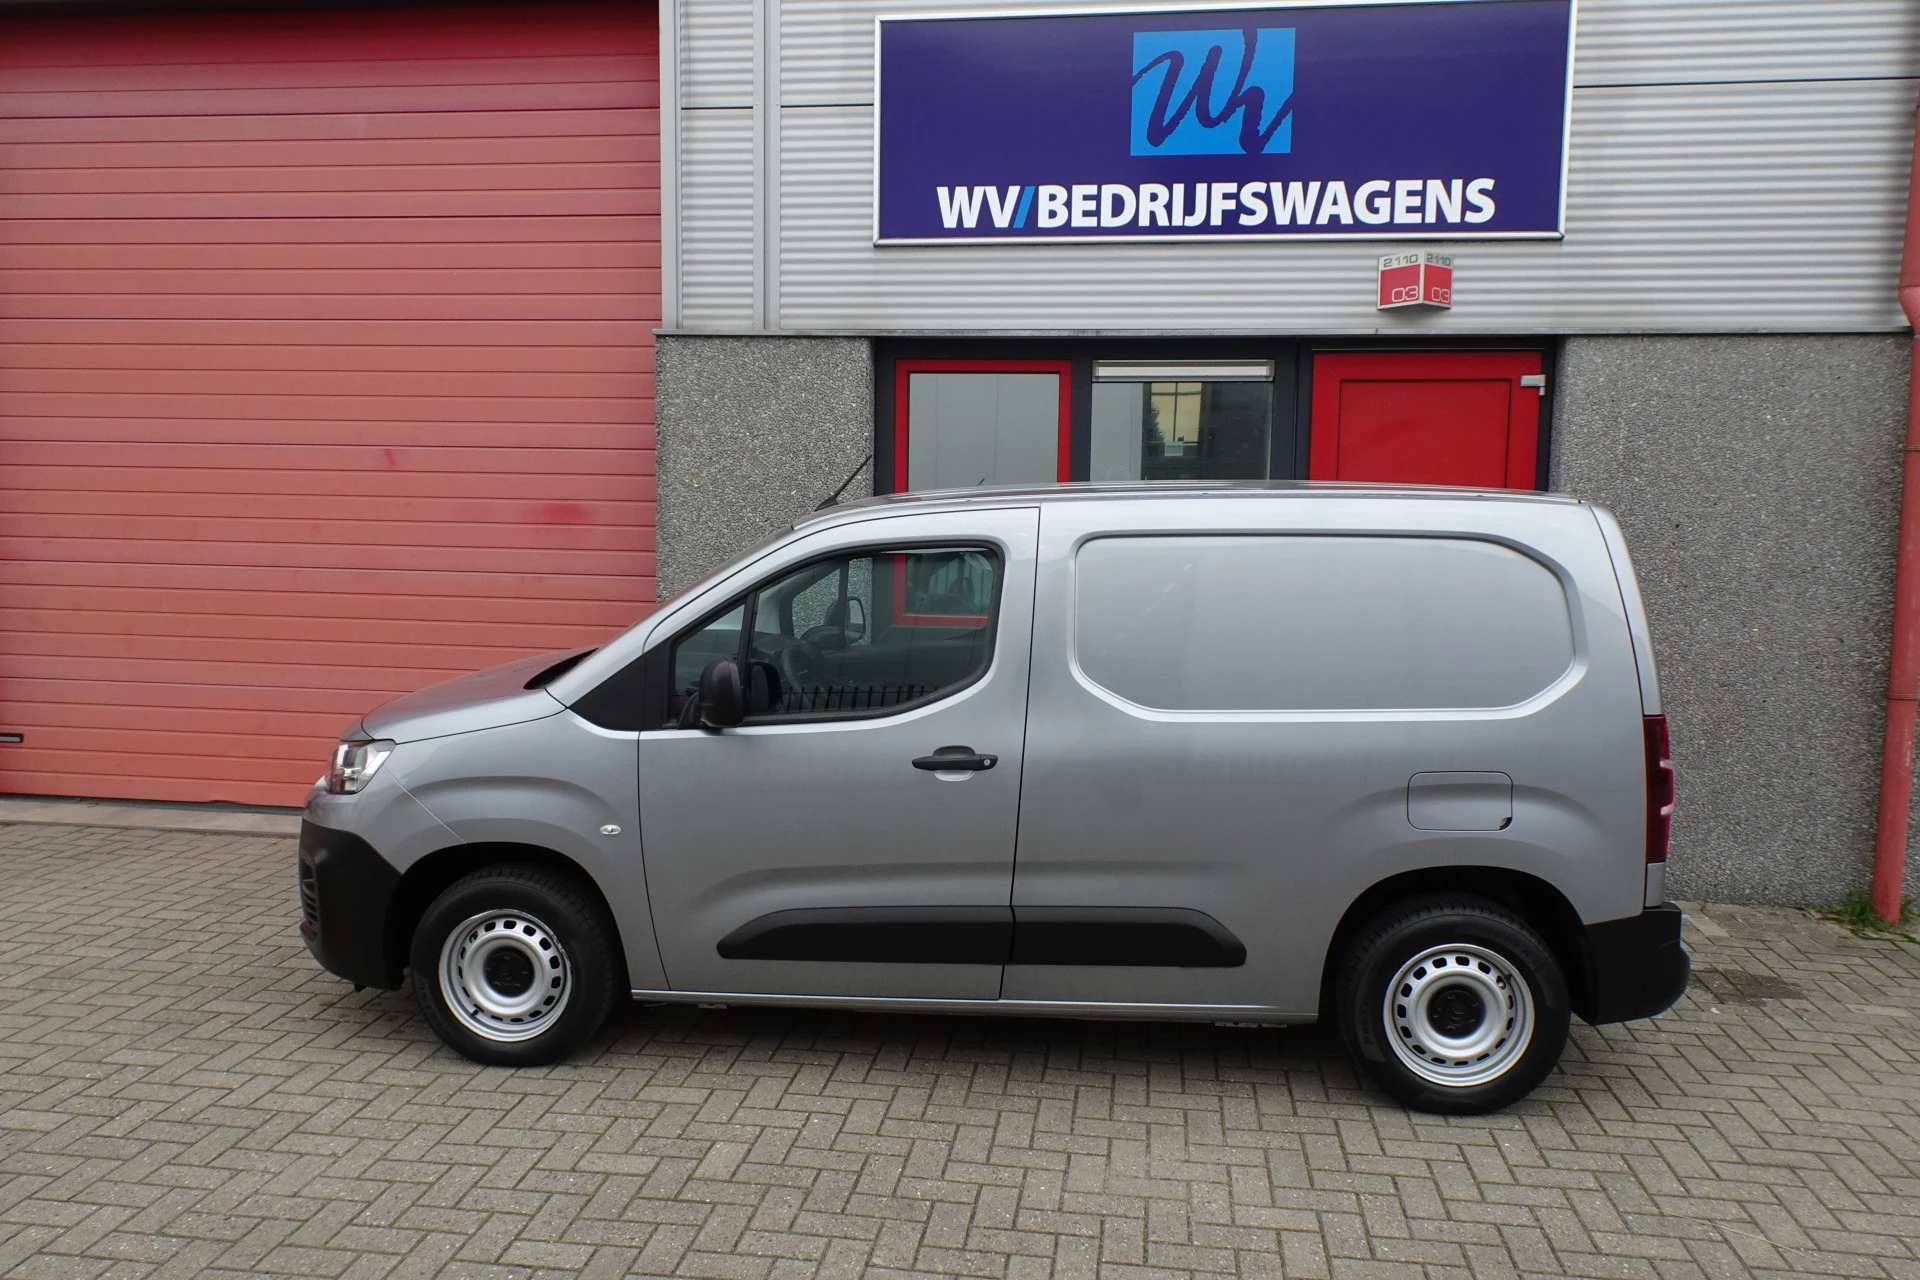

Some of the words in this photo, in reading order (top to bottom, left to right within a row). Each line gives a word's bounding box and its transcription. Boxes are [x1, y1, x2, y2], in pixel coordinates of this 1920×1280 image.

[1383, 253, 1419, 268] 2110
[1426, 253, 1452, 267] 2110
[1391, 285, 1419, 303] 03
[1431, 286, 1451, 303] 03
